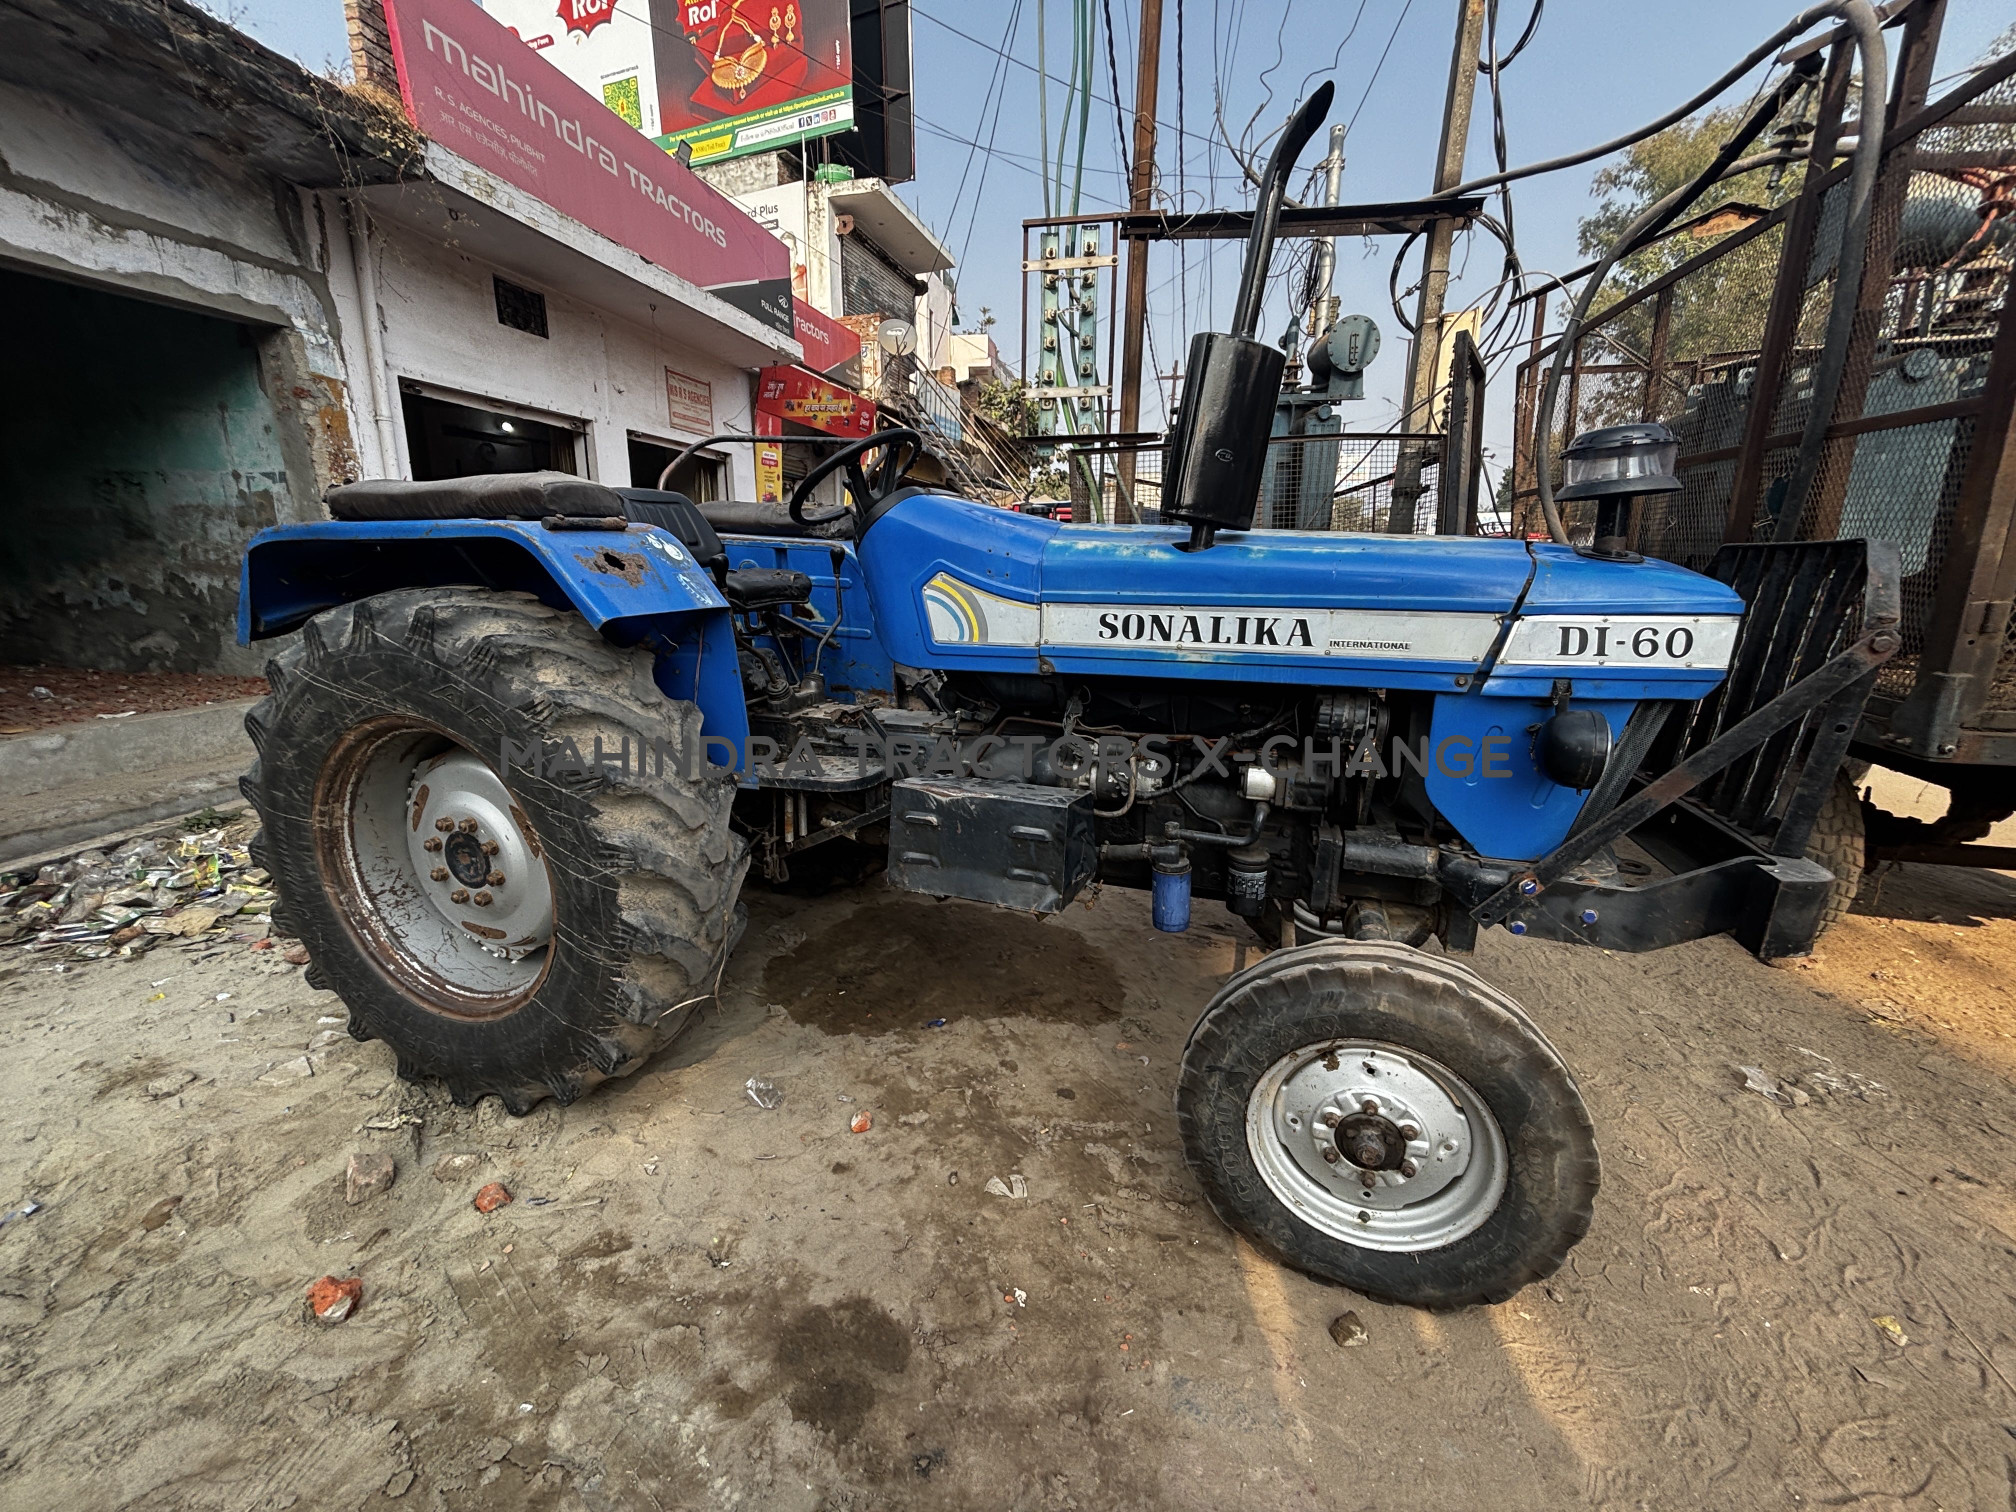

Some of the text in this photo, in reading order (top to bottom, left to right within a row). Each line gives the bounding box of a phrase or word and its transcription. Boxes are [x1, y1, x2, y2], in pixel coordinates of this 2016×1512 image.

[422, 18, 727, 249] mahindra TRACTORS
[759, 203, 779, 217] Plus
[1098, 611, 1412, 652] SONALIKA INTERNATIONAL
[1555, 626, 1694, 659] DI-60
